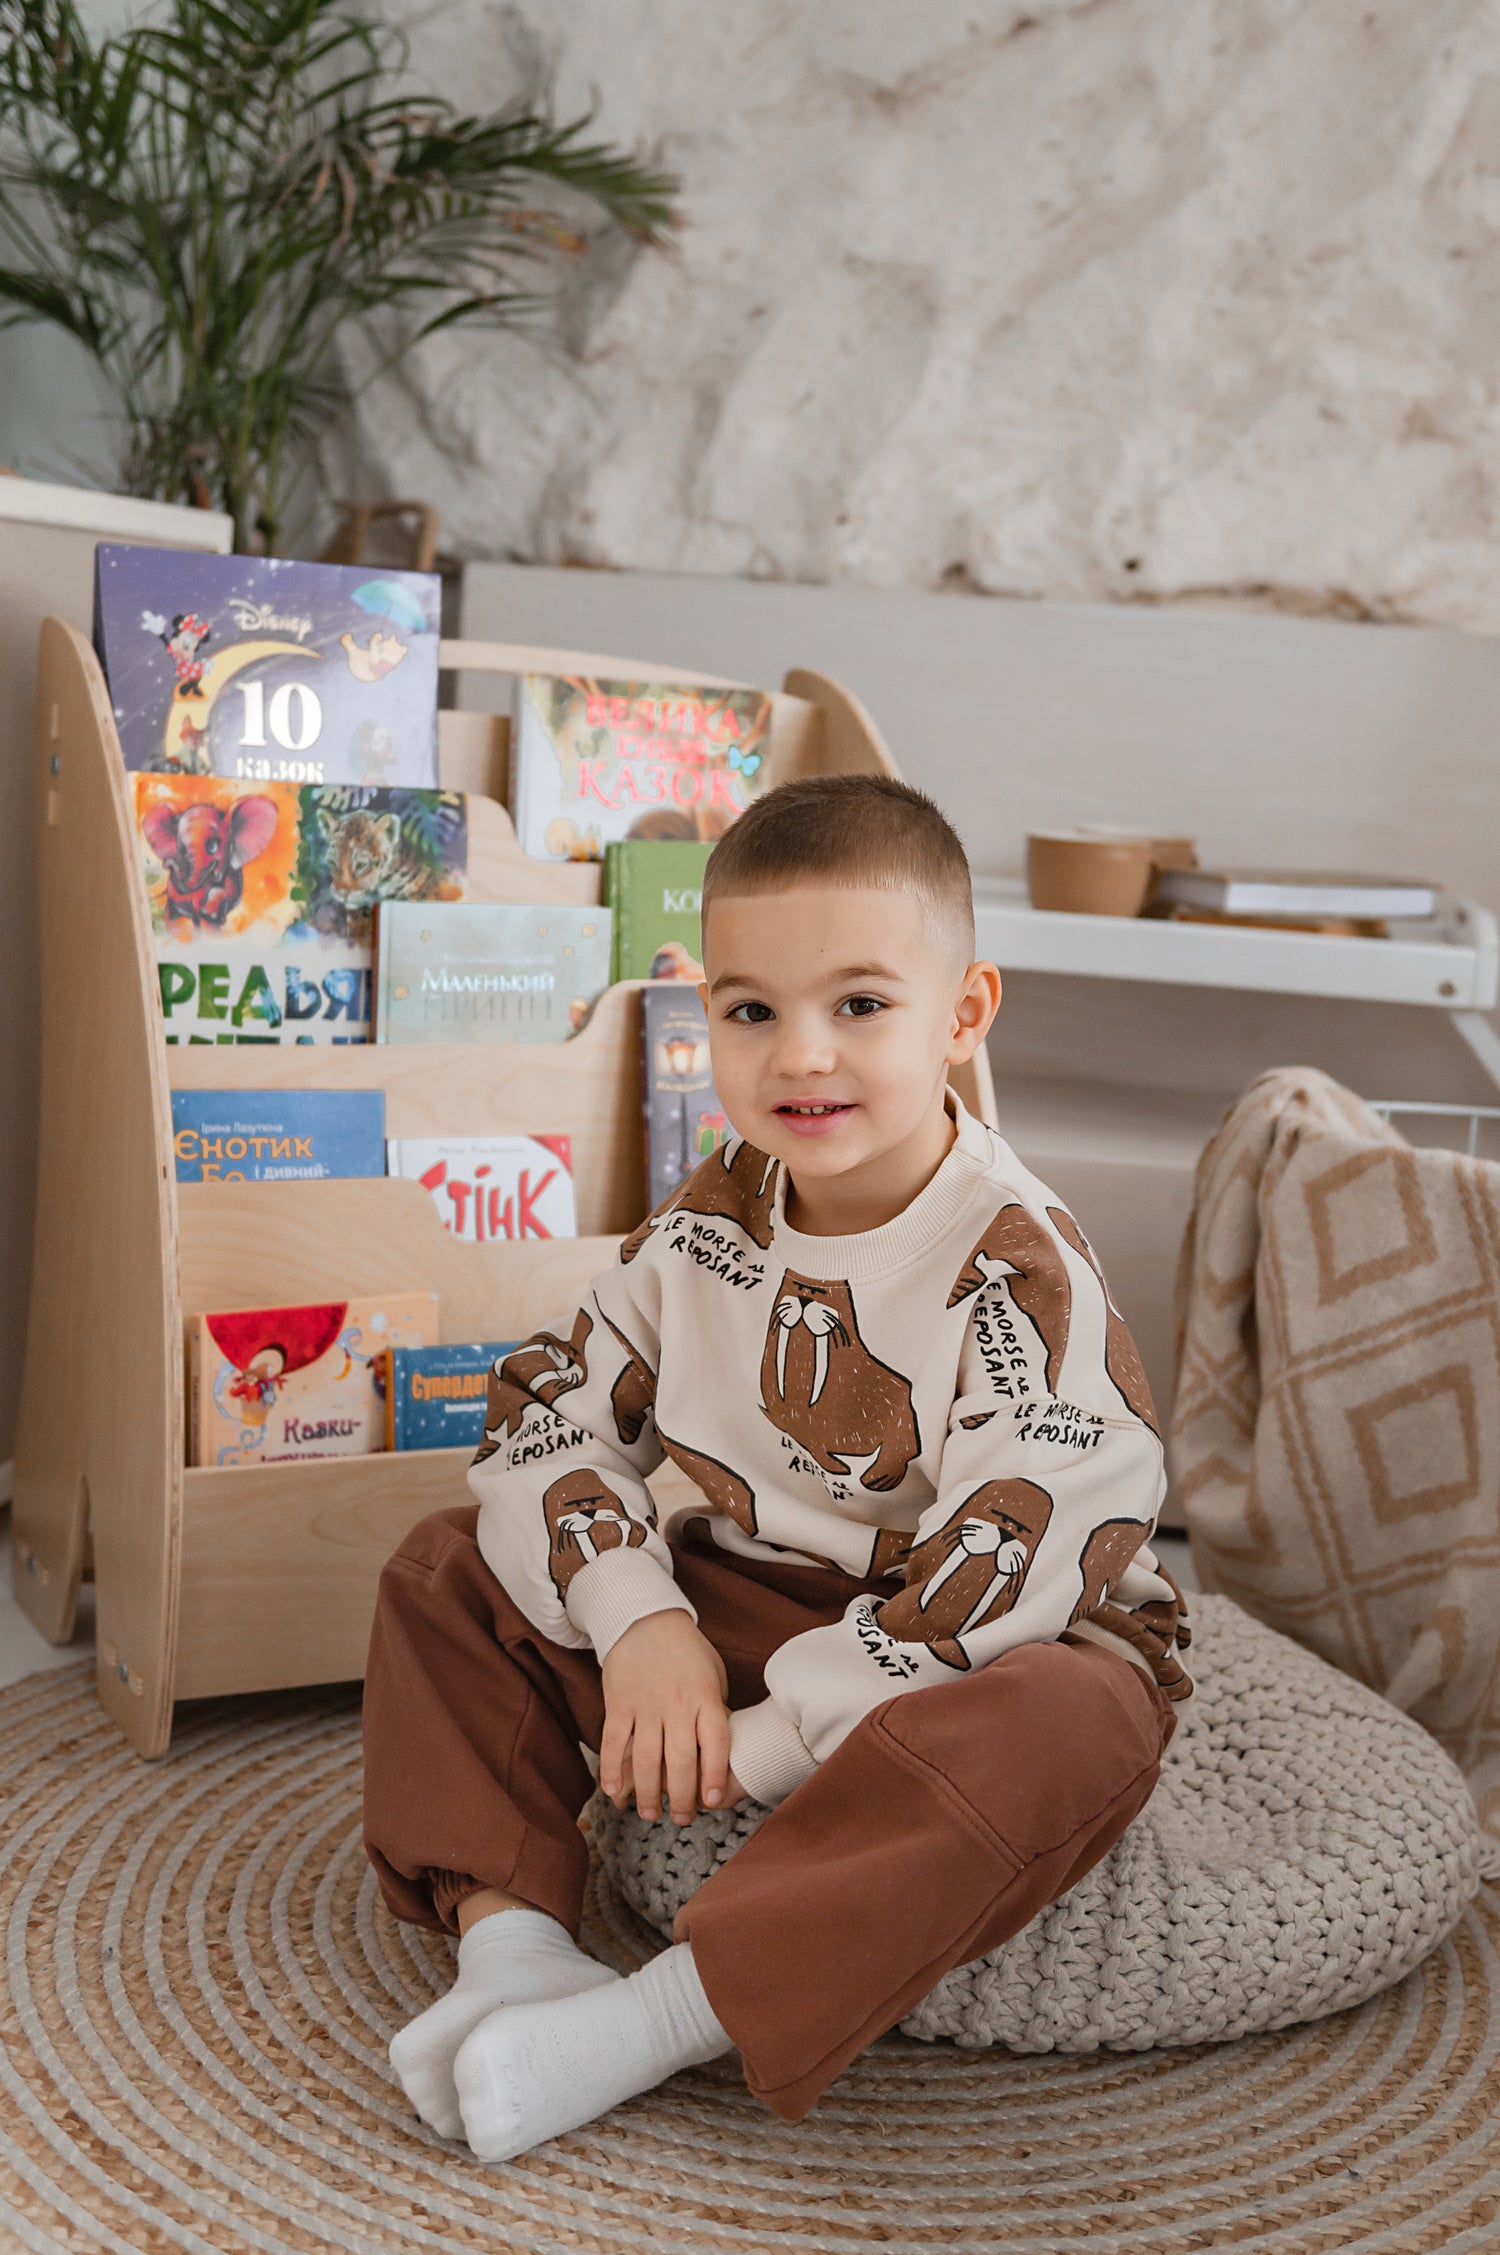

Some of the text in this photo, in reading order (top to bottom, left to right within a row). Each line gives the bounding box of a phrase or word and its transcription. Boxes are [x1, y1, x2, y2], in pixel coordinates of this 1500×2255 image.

[228, 598, 314, 642] Disney
[235, 680, 323, 751] 10
[585, 694, 742, 744] ВЕЛИКА
[577, 760, 745, 816] КАЗОК
[664, 1216, 686, 1232] LE
[691, 1222, 746, 1263] MORSE
[669, 1235, 763, 1291] REPOSANT
[991, 1301, 1028, 1371] MORSE
[1014, 1403, 1037, 1419] LE
[510, 1429, 594, 1466] EPOSAN
[1015, 1422, 1105, 1450] REPOSANT
